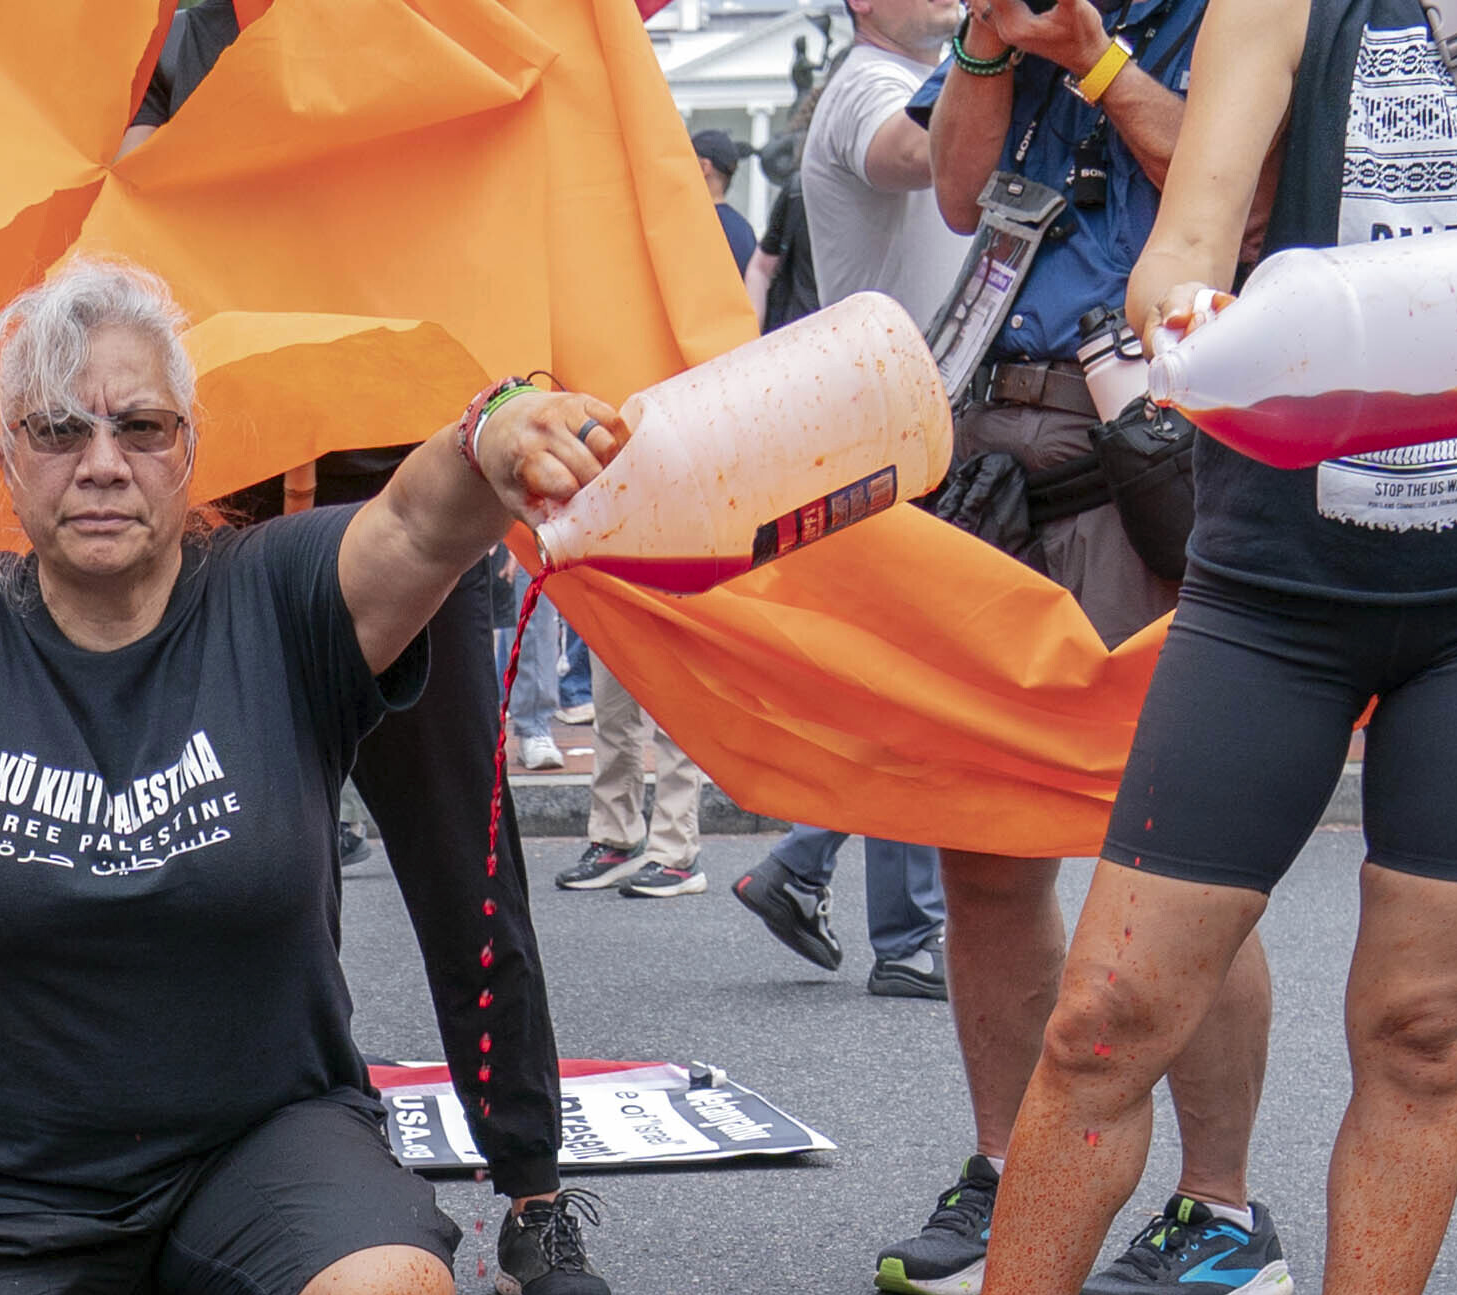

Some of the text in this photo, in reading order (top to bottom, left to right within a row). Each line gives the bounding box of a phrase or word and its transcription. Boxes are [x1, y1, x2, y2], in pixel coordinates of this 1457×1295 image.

[1374, 481, 1404, 498] STOP
[1406, 481, 1428, 498] THE
[1429, 481, 1445, 496] US
[78, 791, 241, 853] PALESTINE
[90, 826, 232, 876] فلسطين
[620, 1104, 659, 1120] of
[685, 1088, 774, 1142] Netanyahu
